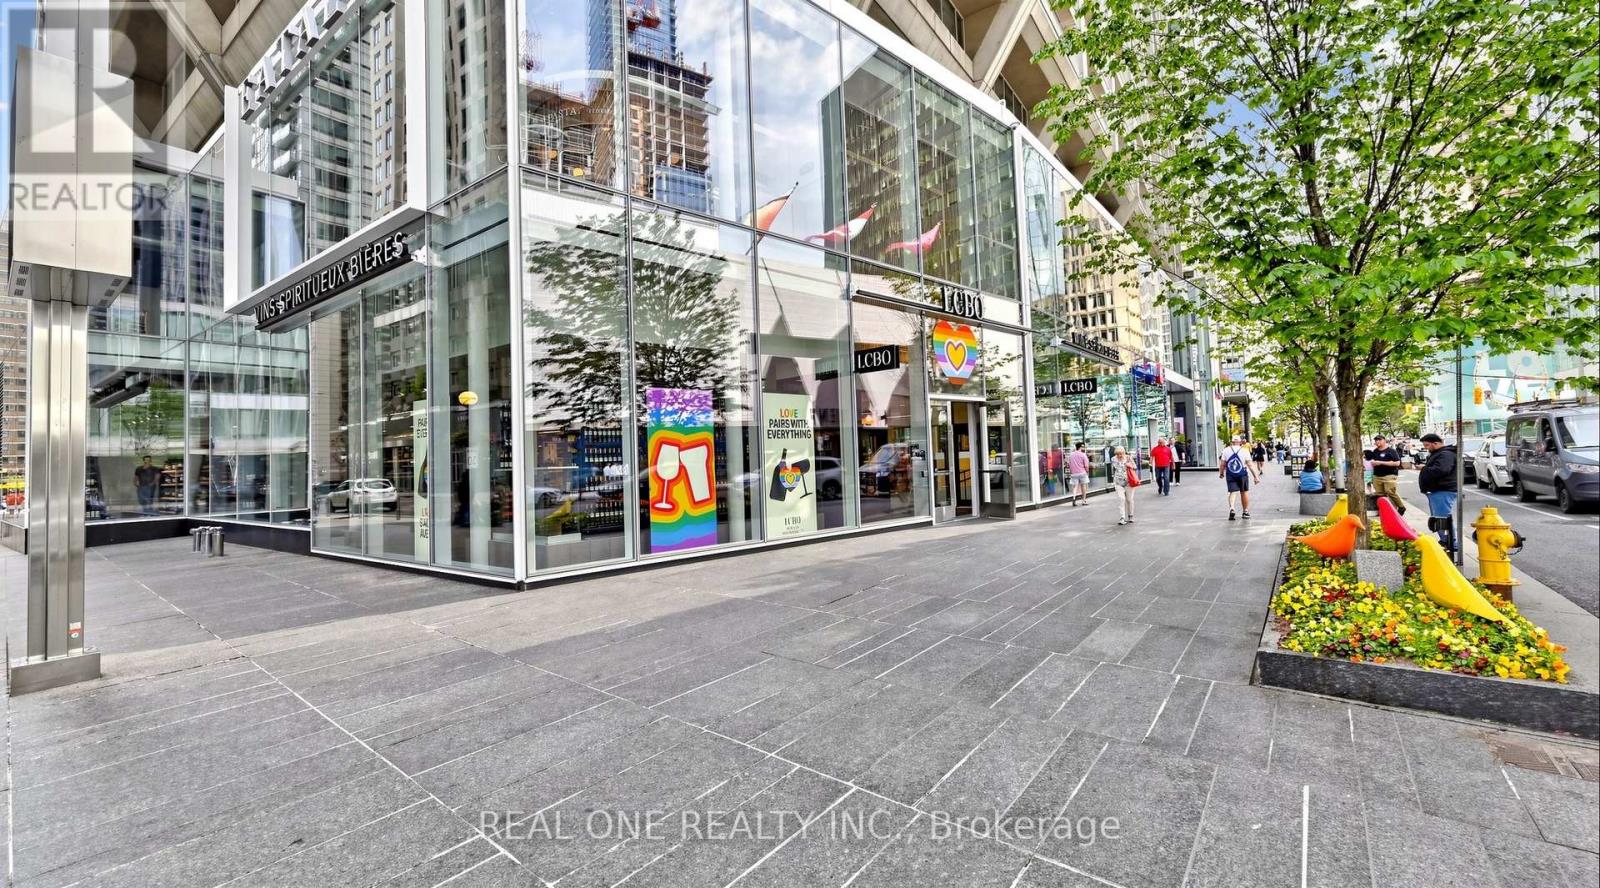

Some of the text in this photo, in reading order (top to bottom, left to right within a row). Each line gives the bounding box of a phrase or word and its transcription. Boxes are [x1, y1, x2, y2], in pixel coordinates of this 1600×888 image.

[254, 231, 404, 322] VINS SPIRITUEUX BIÈRES
[943, 285, 984, 319] LCBO
[857, 350, 891, 369] LCBO
[1064, 381, 1093, 393] LCBO
[780, 408, 798, 418] LOVE
[769, 419, 809, 428] PAIRS WITH
[767, 429, 812, 439] EVERYTHING
